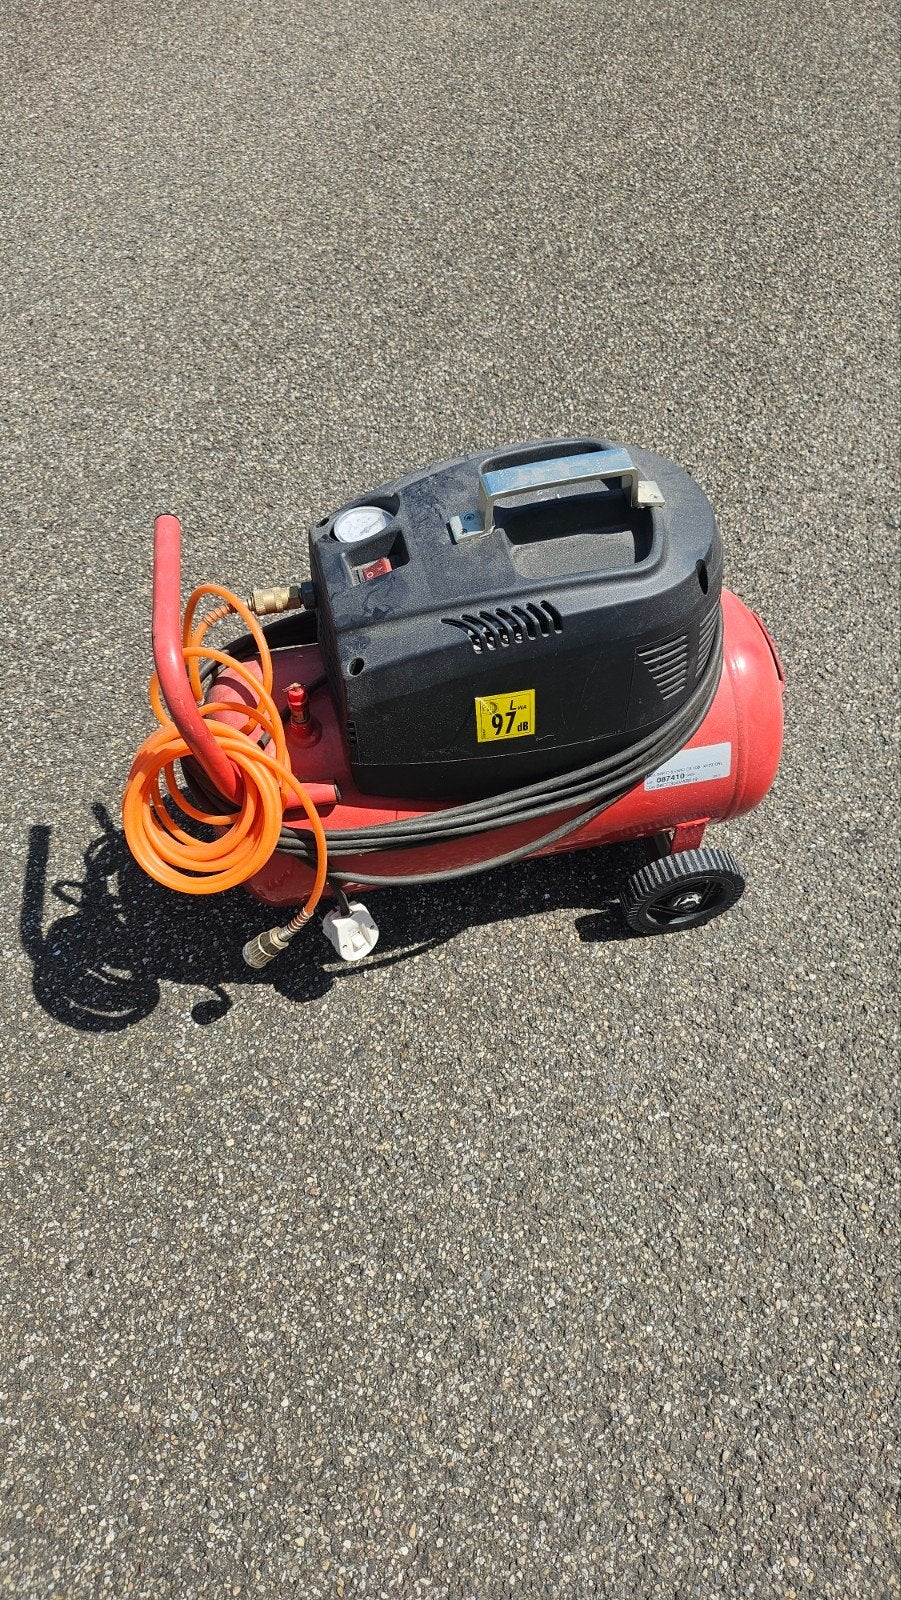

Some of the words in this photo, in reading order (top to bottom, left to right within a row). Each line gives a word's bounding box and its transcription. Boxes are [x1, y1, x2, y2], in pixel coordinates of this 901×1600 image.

[491, 711, 517, 735] 97
[517, 721, 529, 732] dB
[656, 773, 685, 784] 087410
